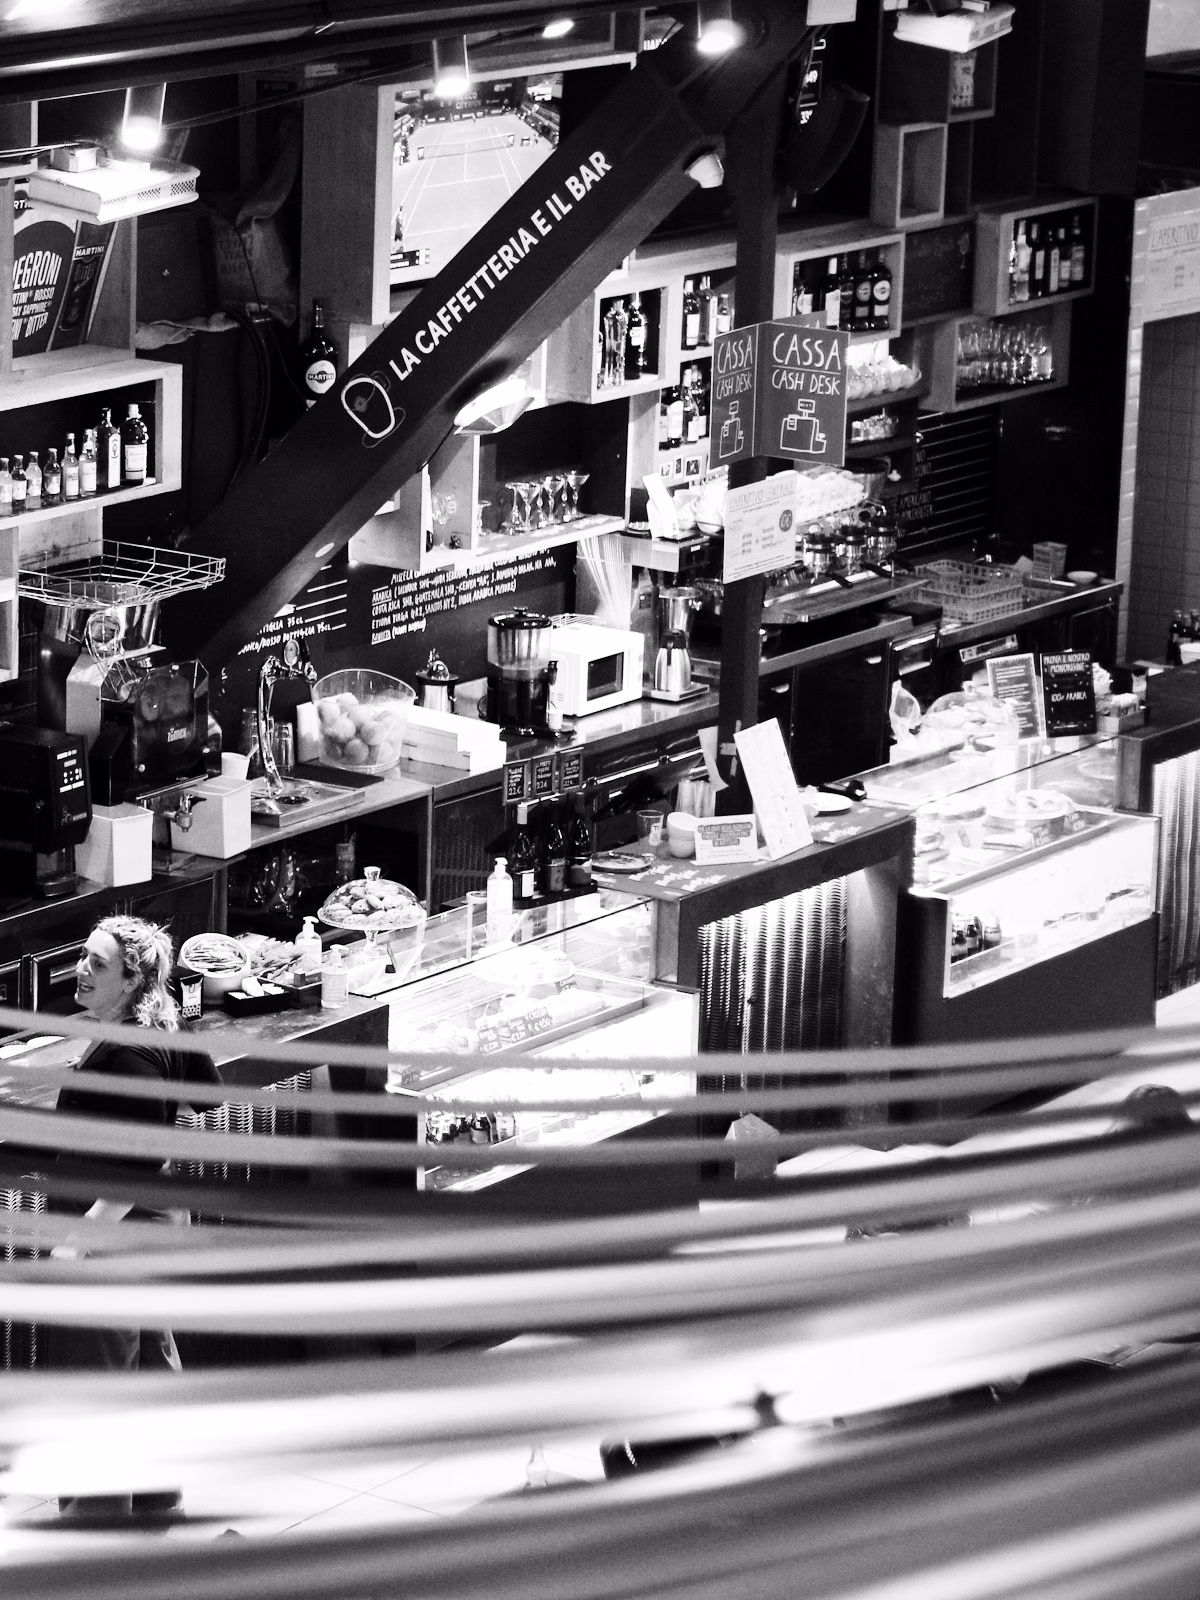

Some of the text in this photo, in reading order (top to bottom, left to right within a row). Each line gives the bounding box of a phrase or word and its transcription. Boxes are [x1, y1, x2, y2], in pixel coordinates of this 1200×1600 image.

[75, 246, 105, 257] MARTINI
[389, 150, 612, 381] LA CAFFETTERIA E IL BAR
[33, 287, 55, 302] ROSSO
[24, 312, 49, 338] BITTER
[717, 334, 753, 374] CASSA
[772, 332, 841, 371] CASSA
[308, 372, 334, 381] MARTINI
[716, 371, 753, 400] CASH DESK
[772, 369, 841, 396] CASH DESK
